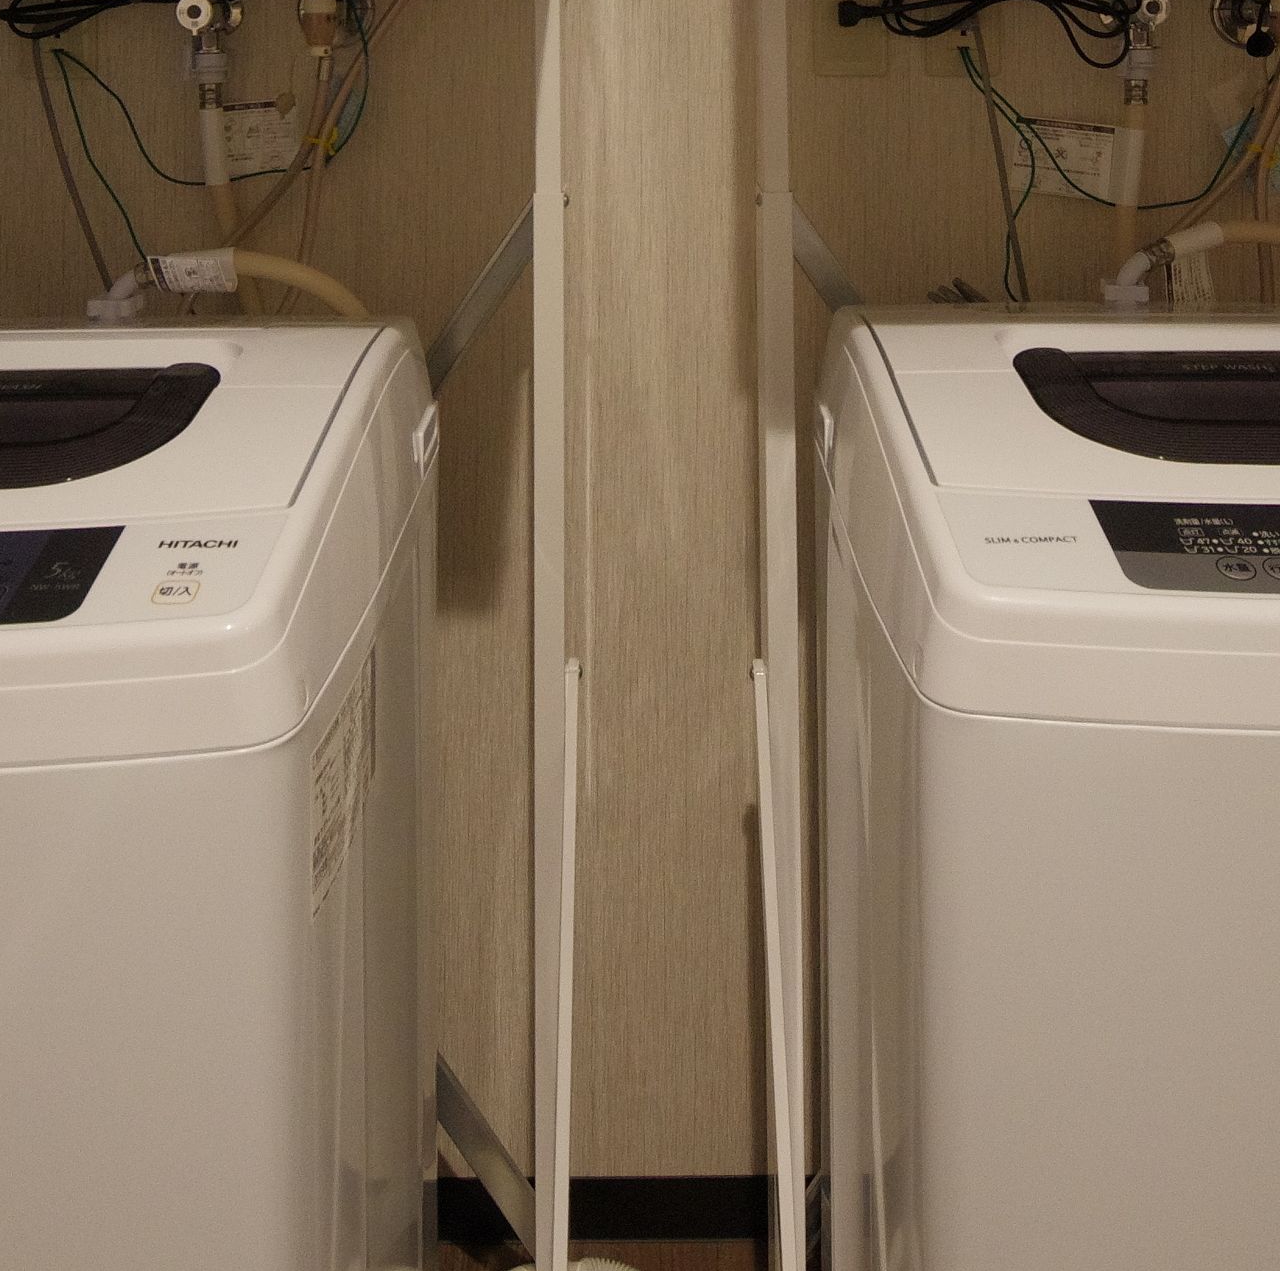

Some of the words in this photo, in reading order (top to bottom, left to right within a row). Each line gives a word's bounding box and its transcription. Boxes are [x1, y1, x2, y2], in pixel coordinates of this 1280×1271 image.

[158, 539, 238, 549] HITACHI
[984, 536, 1012, 544] SLIM
[1020, 536, 1078, 544] COMPACT
[1242, 546, 1258, 554] 20
[158, 586, 192, 598] 切/入
